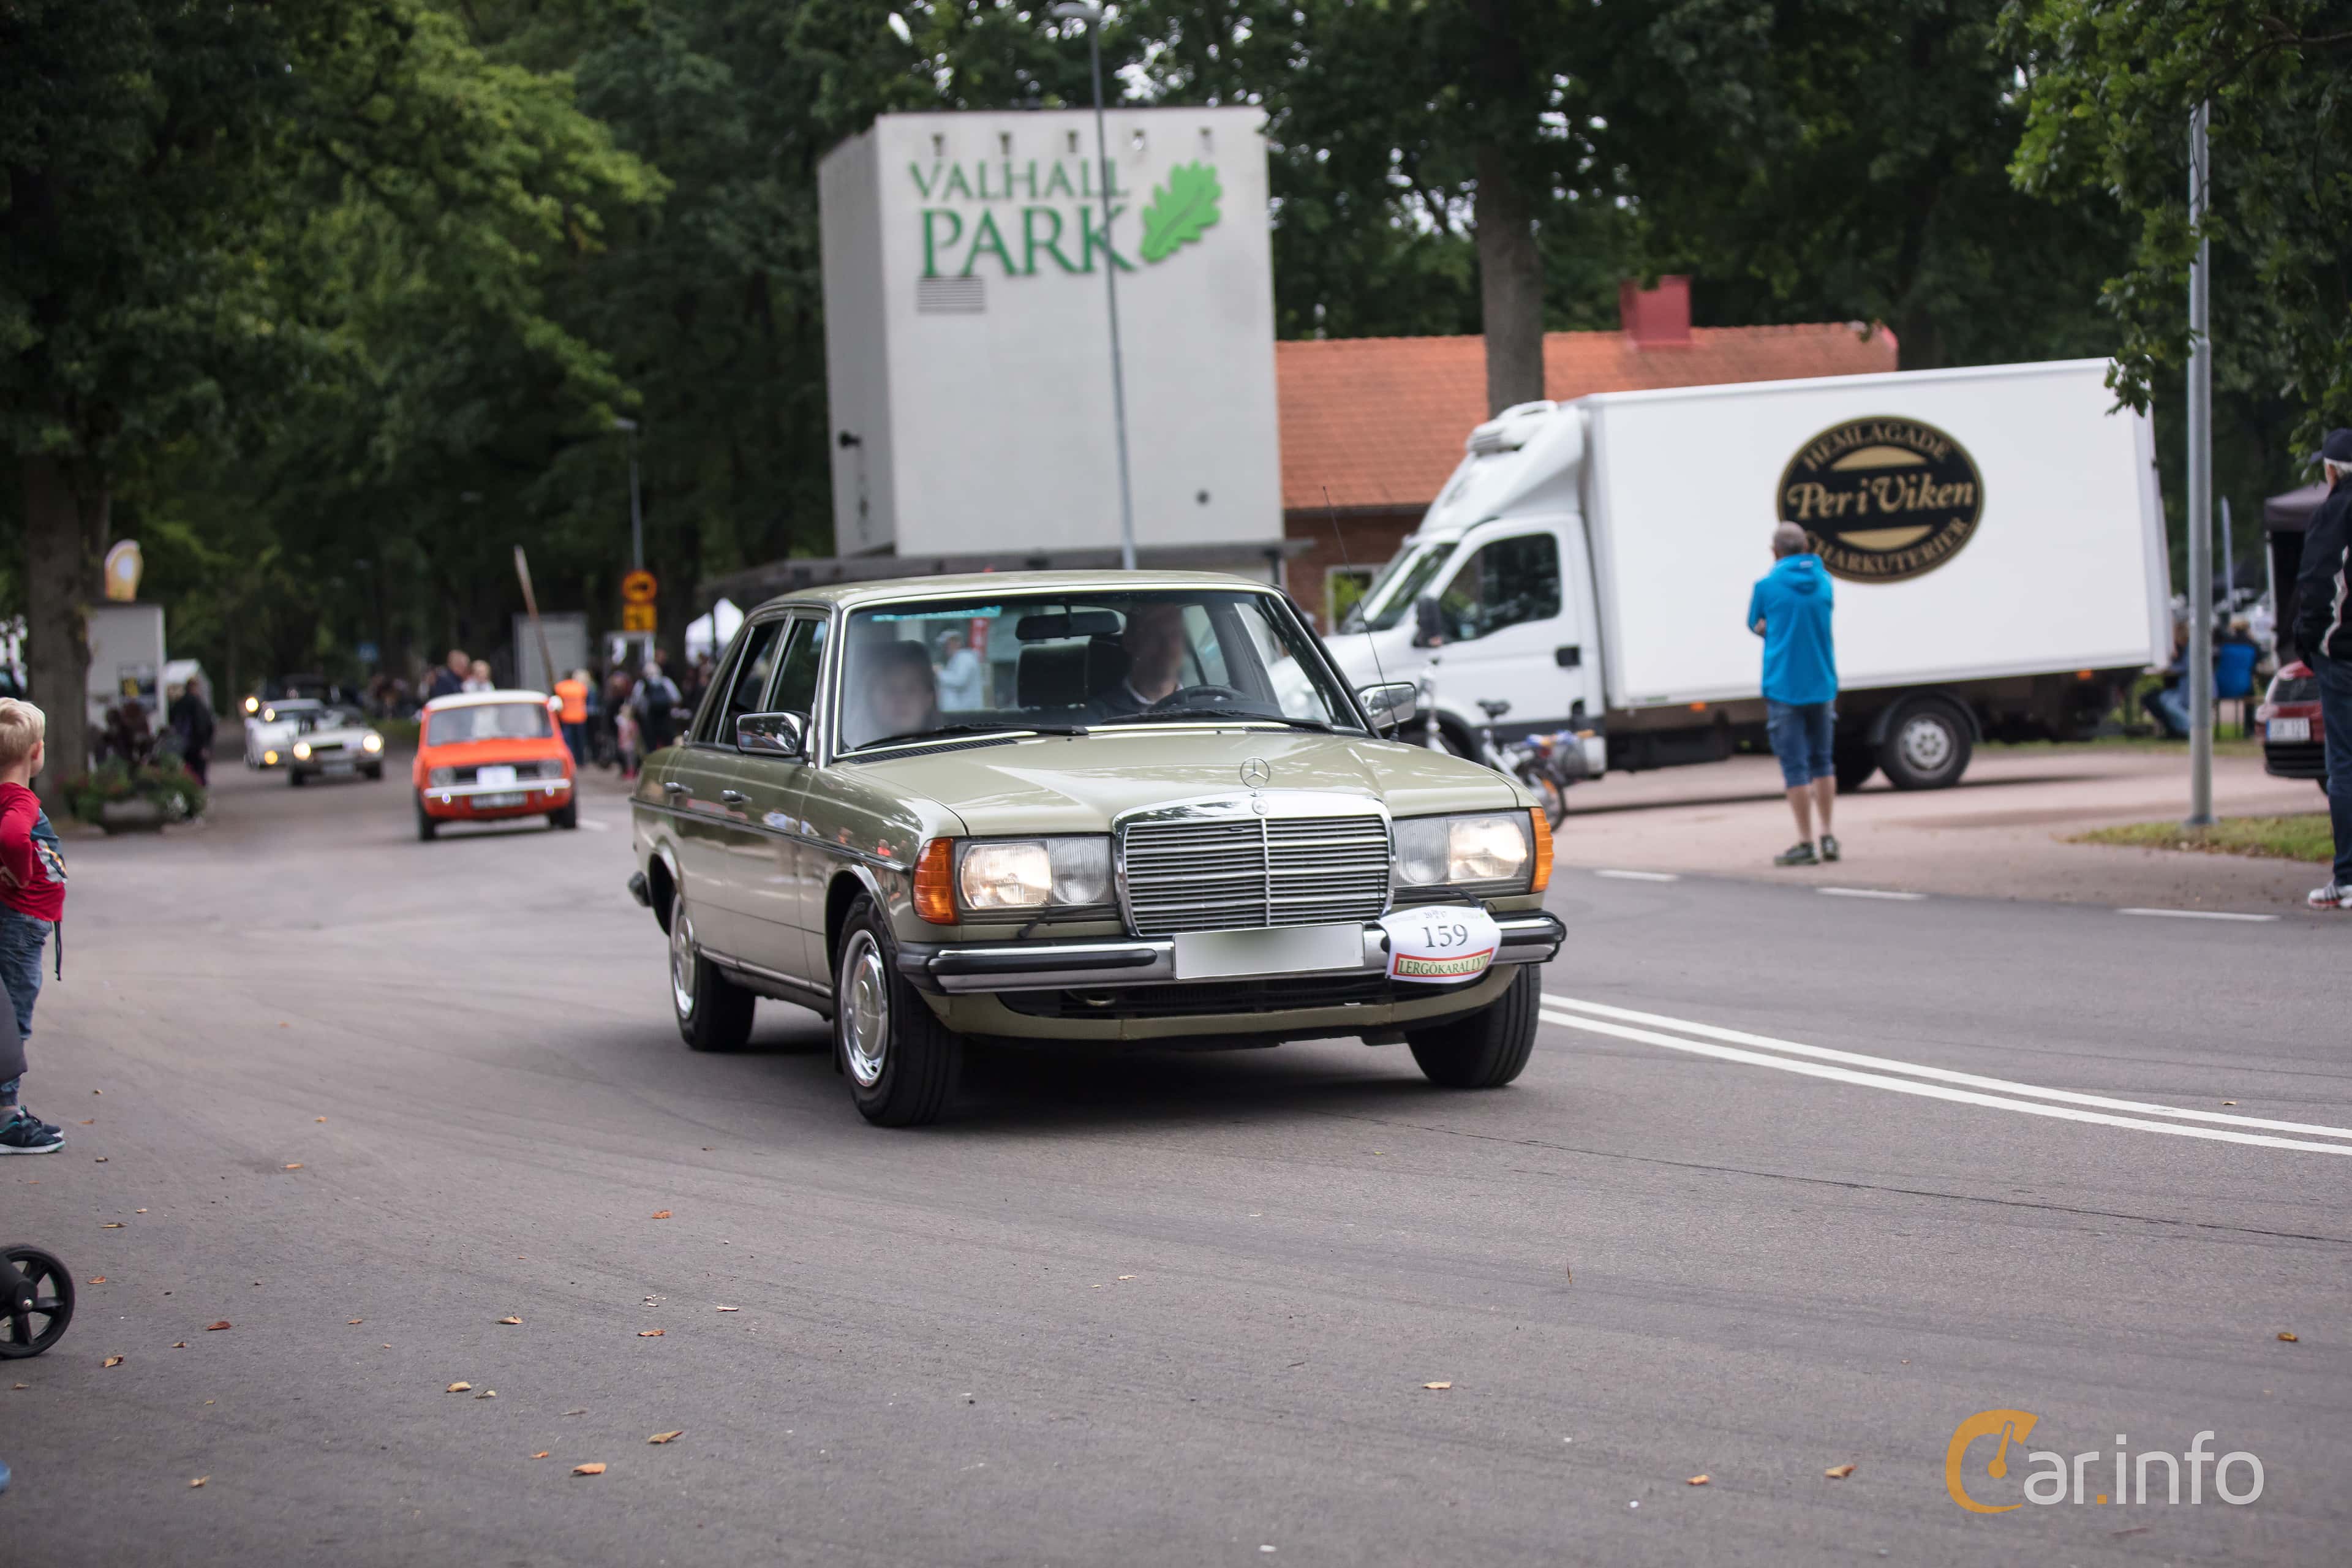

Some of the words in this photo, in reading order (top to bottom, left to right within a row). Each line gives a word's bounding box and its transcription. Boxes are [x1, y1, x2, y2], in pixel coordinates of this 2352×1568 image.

[909, 159, 1131, 200] VALHALL
[922, 205, 1136, 277] PARK
[1787, 483, 1852, 519] Per
[1871, 473, 1973, 513] Viken
[1421, 924, 1468, 948] 159
